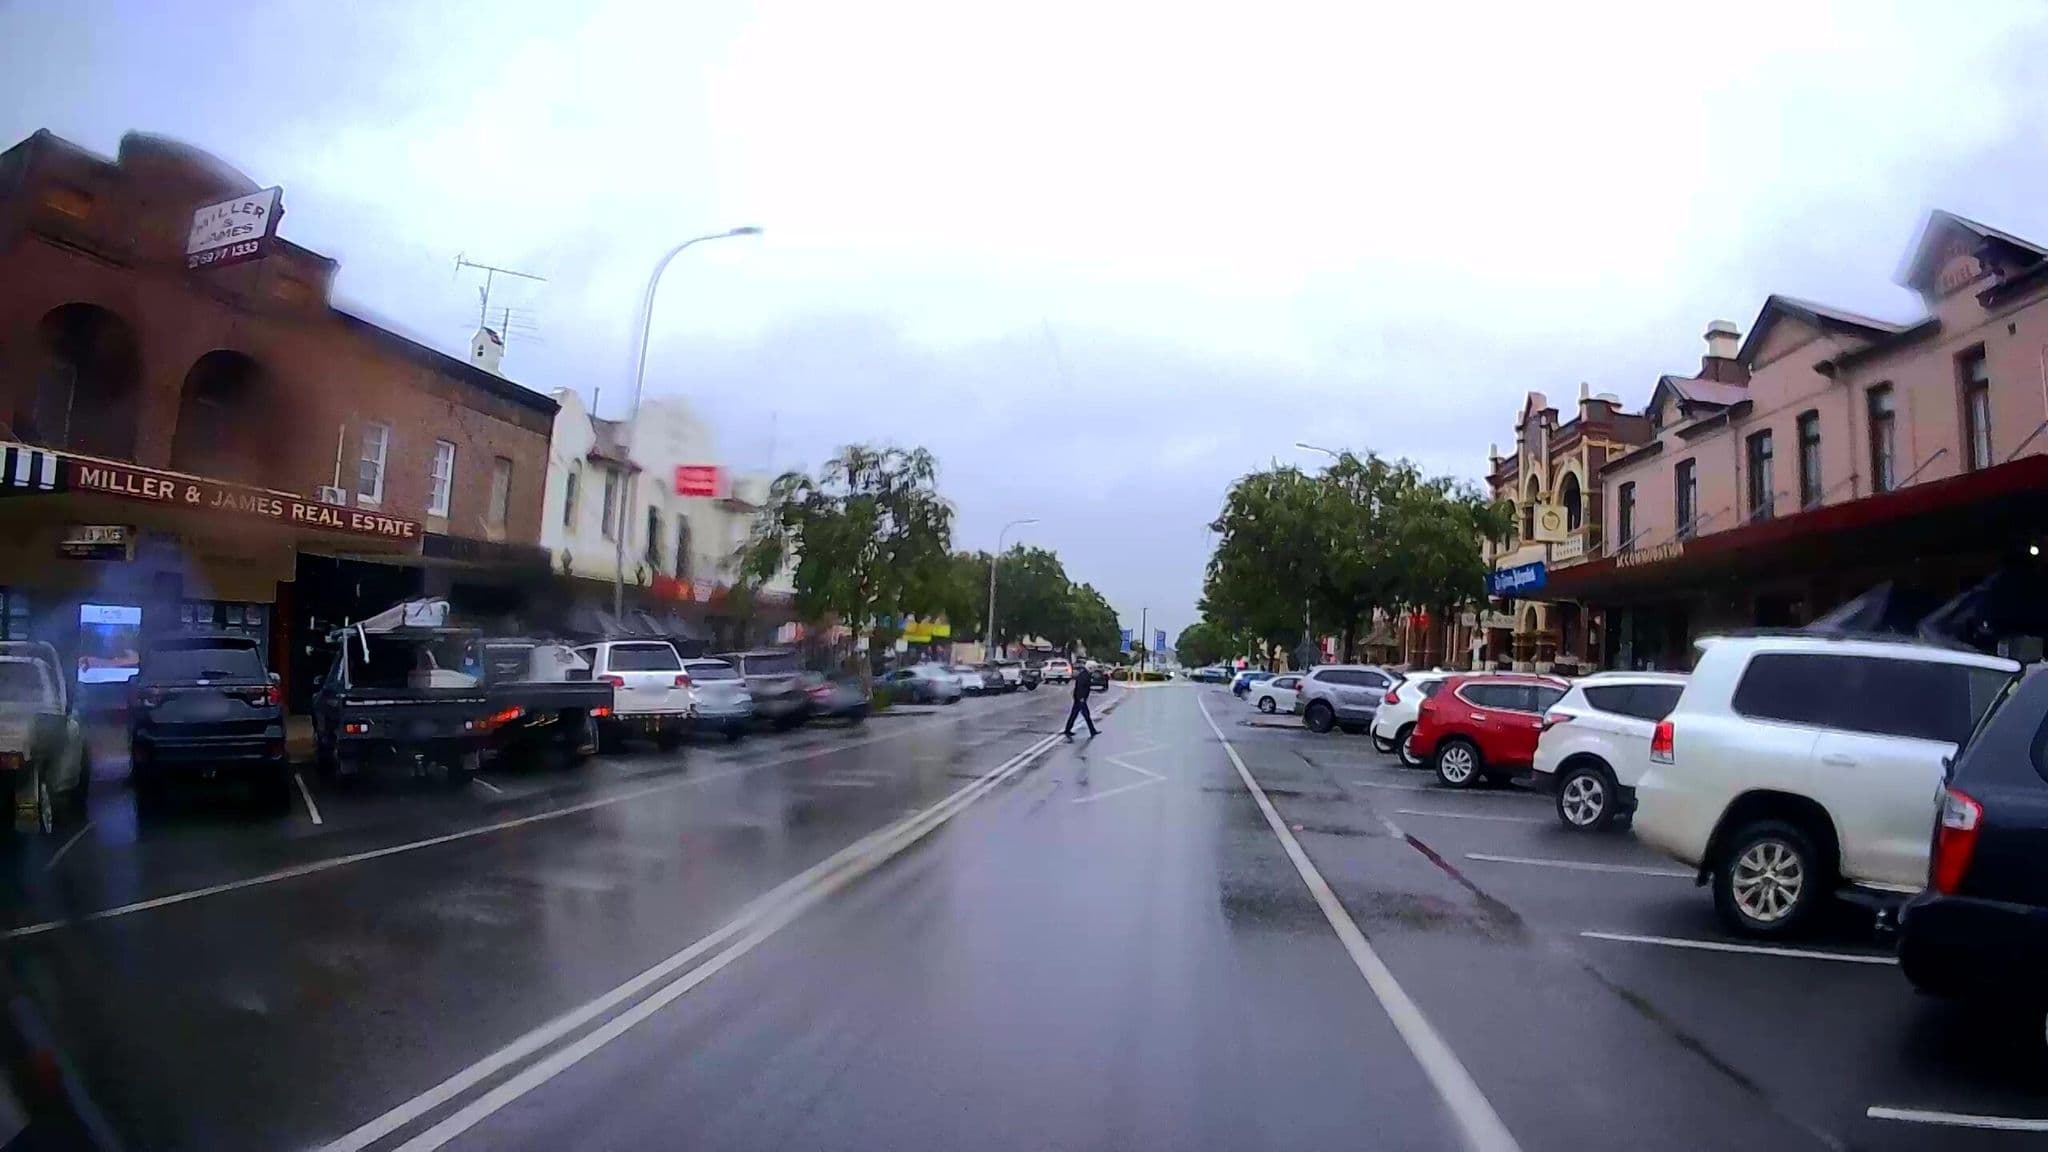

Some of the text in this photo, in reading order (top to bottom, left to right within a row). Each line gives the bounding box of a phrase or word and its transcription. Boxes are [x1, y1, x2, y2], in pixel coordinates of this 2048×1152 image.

[79, 466, 415, 538] MILLER & JAMES REAL ESTATE
